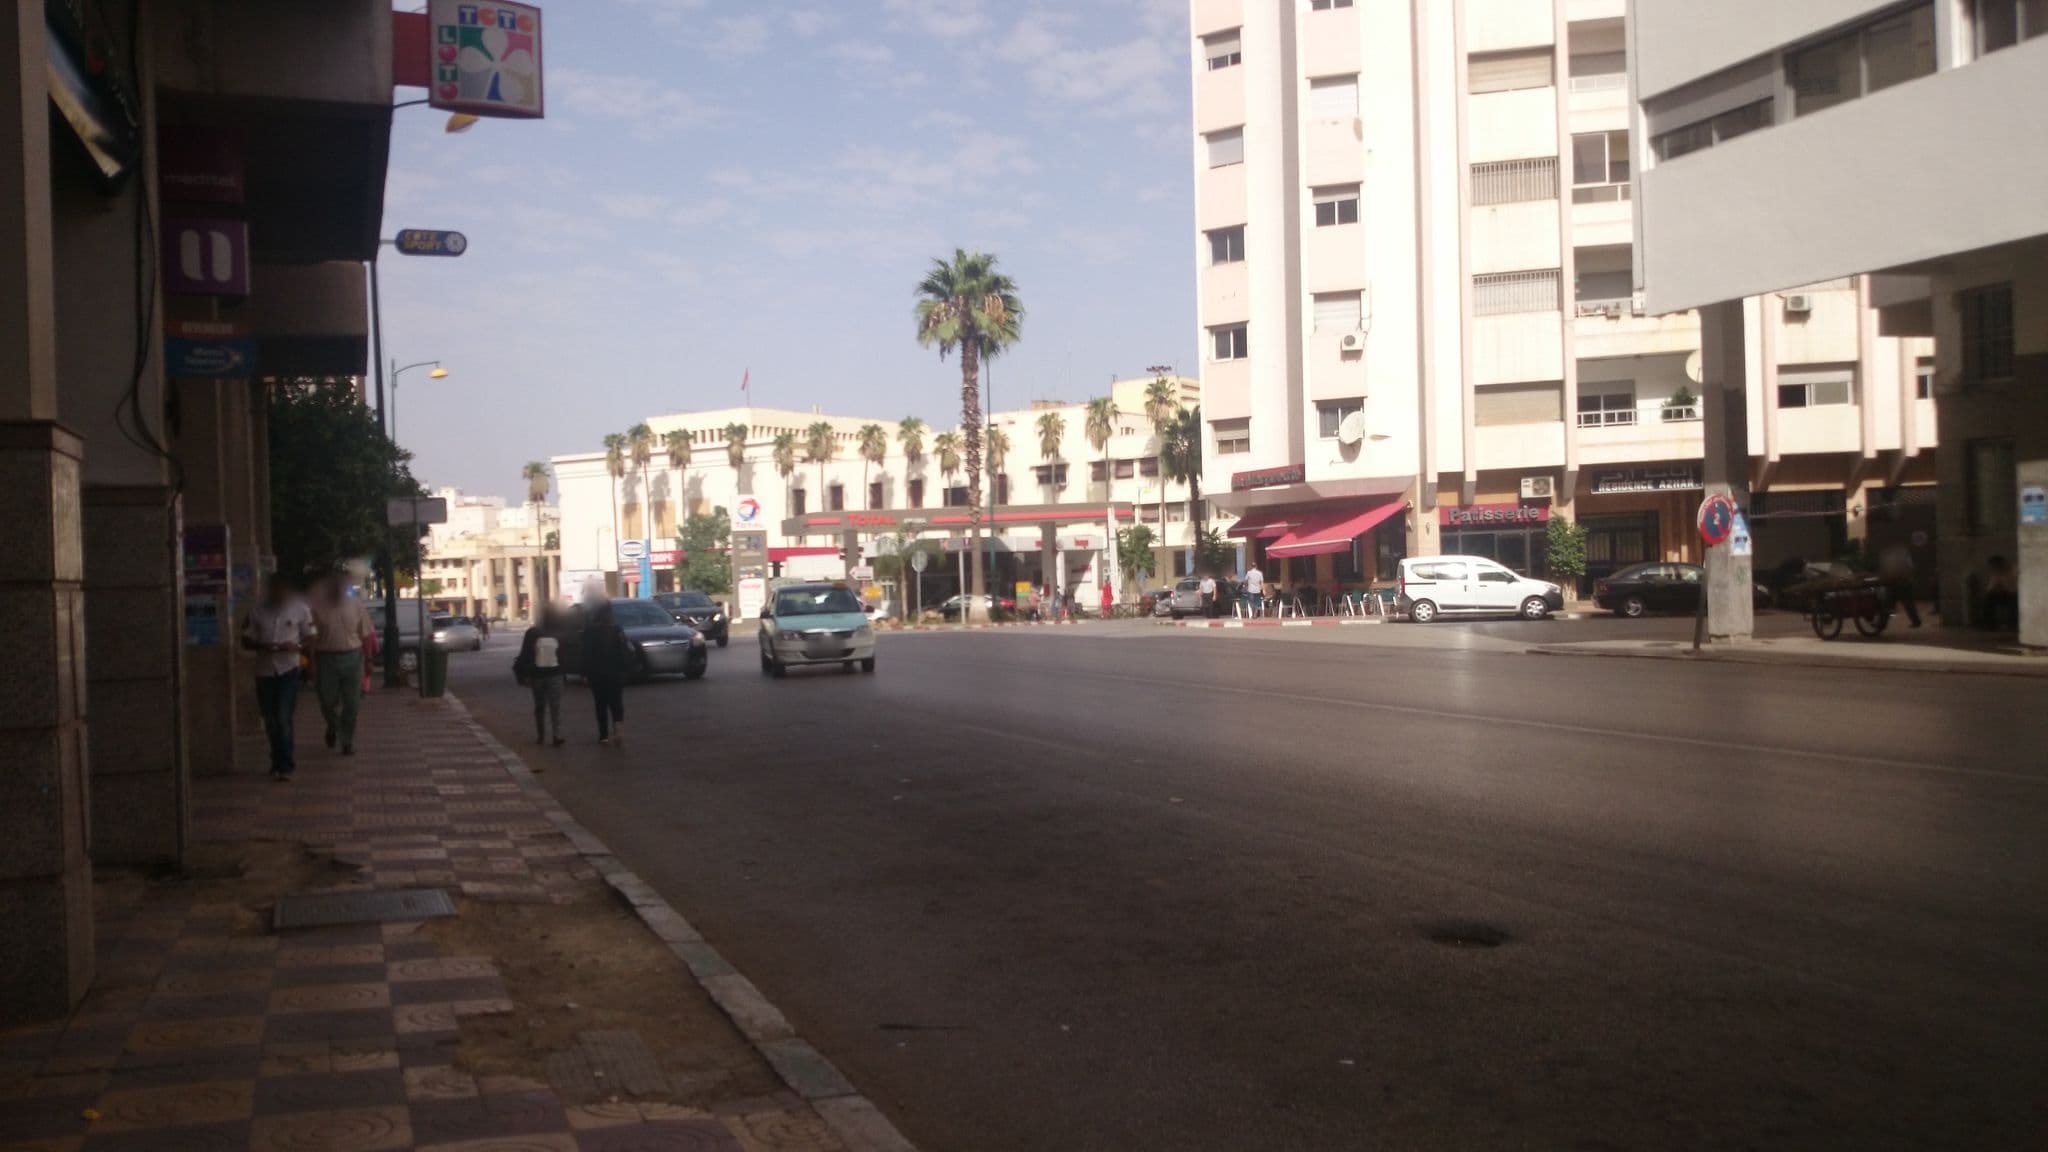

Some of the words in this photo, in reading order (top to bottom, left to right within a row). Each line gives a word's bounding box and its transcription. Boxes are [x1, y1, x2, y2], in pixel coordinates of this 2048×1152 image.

[1598, 480, 1654, 493] RESIDENCE
[847, 512, 897, 527] TOTAL
[1450, 506, 1540, 521] Patisserie
